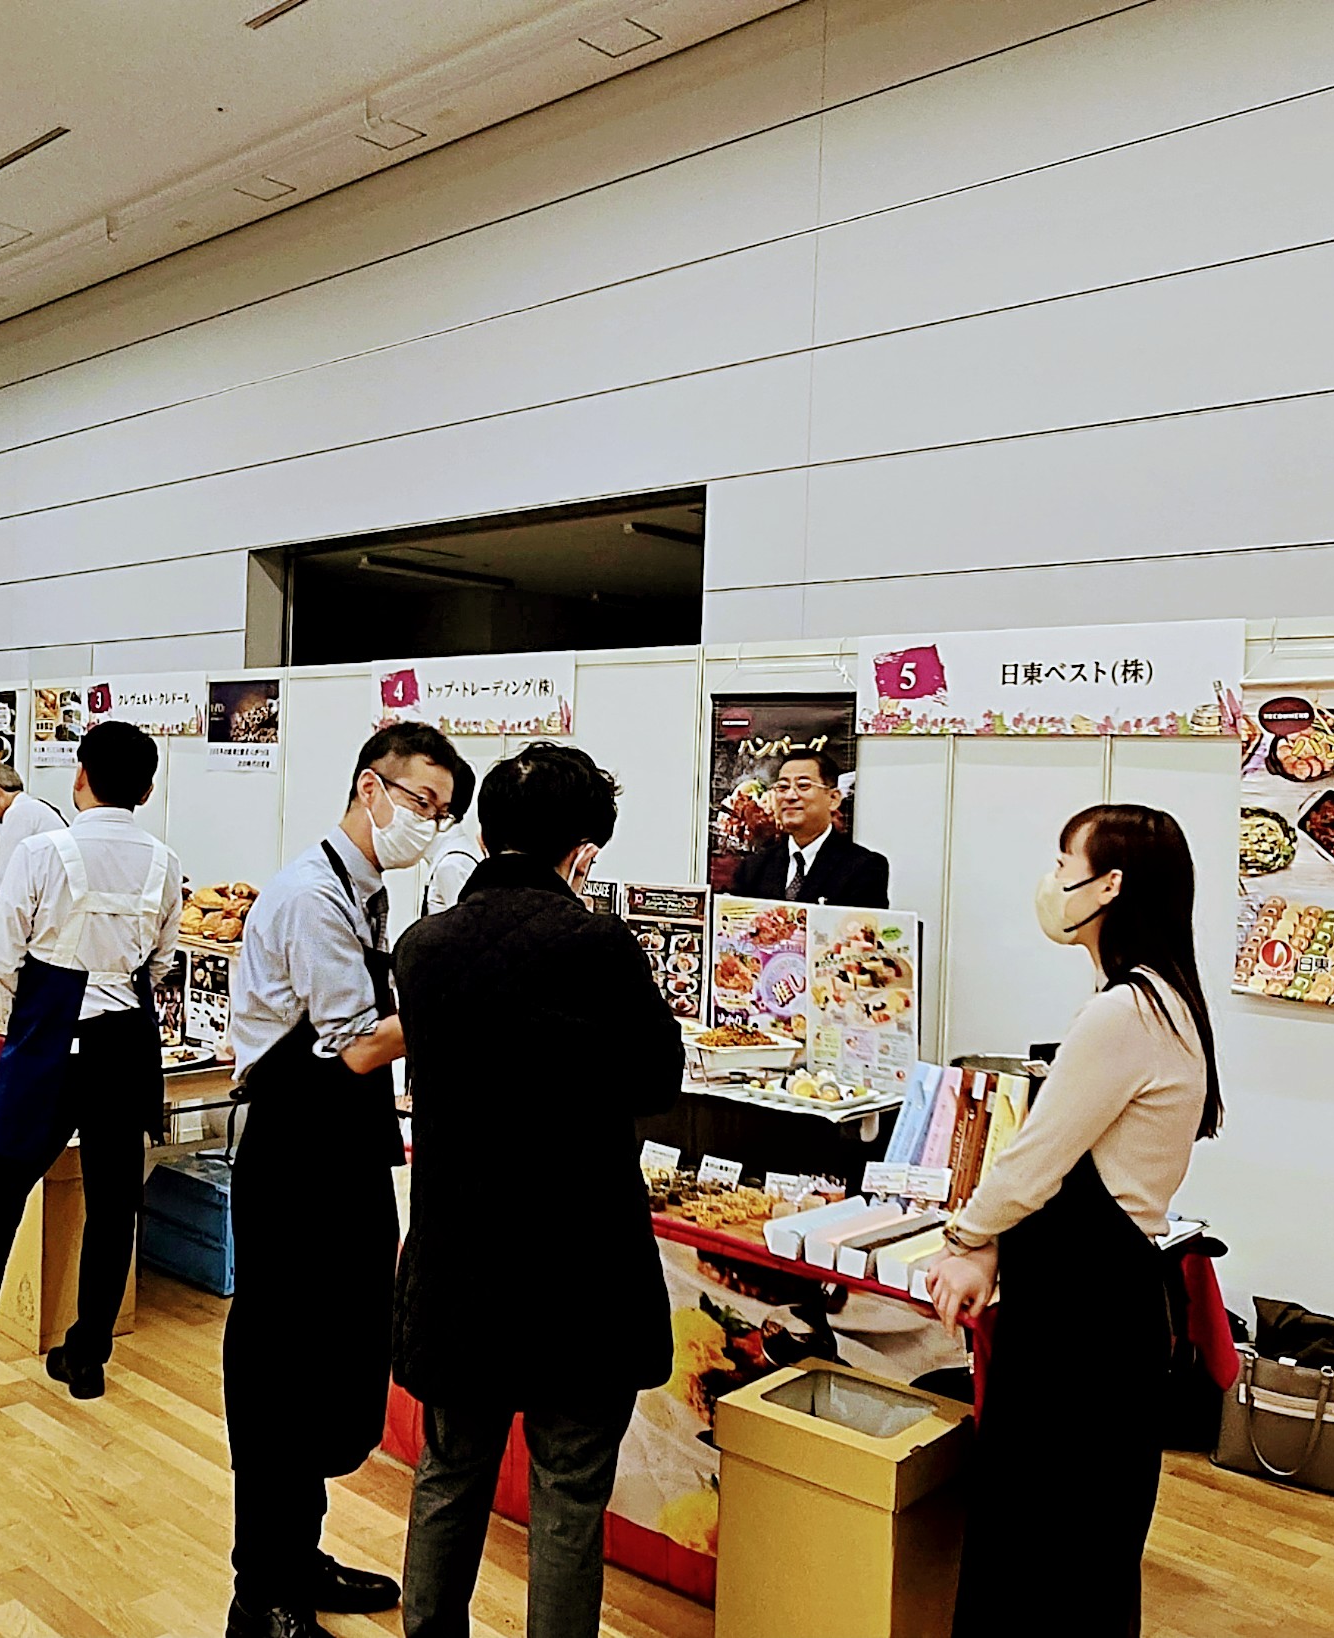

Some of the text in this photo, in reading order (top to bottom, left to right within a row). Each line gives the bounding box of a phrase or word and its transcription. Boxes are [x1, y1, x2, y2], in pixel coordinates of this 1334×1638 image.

[899, 662, 917, 690] 5
[1000, 658, 1154, 687] 日東ベスト(株)
[393, 680, 405, 701] 4
[427, 677, 555, 699] トップ・トレーディング(株)
[95, 691, 103, 709] 3
